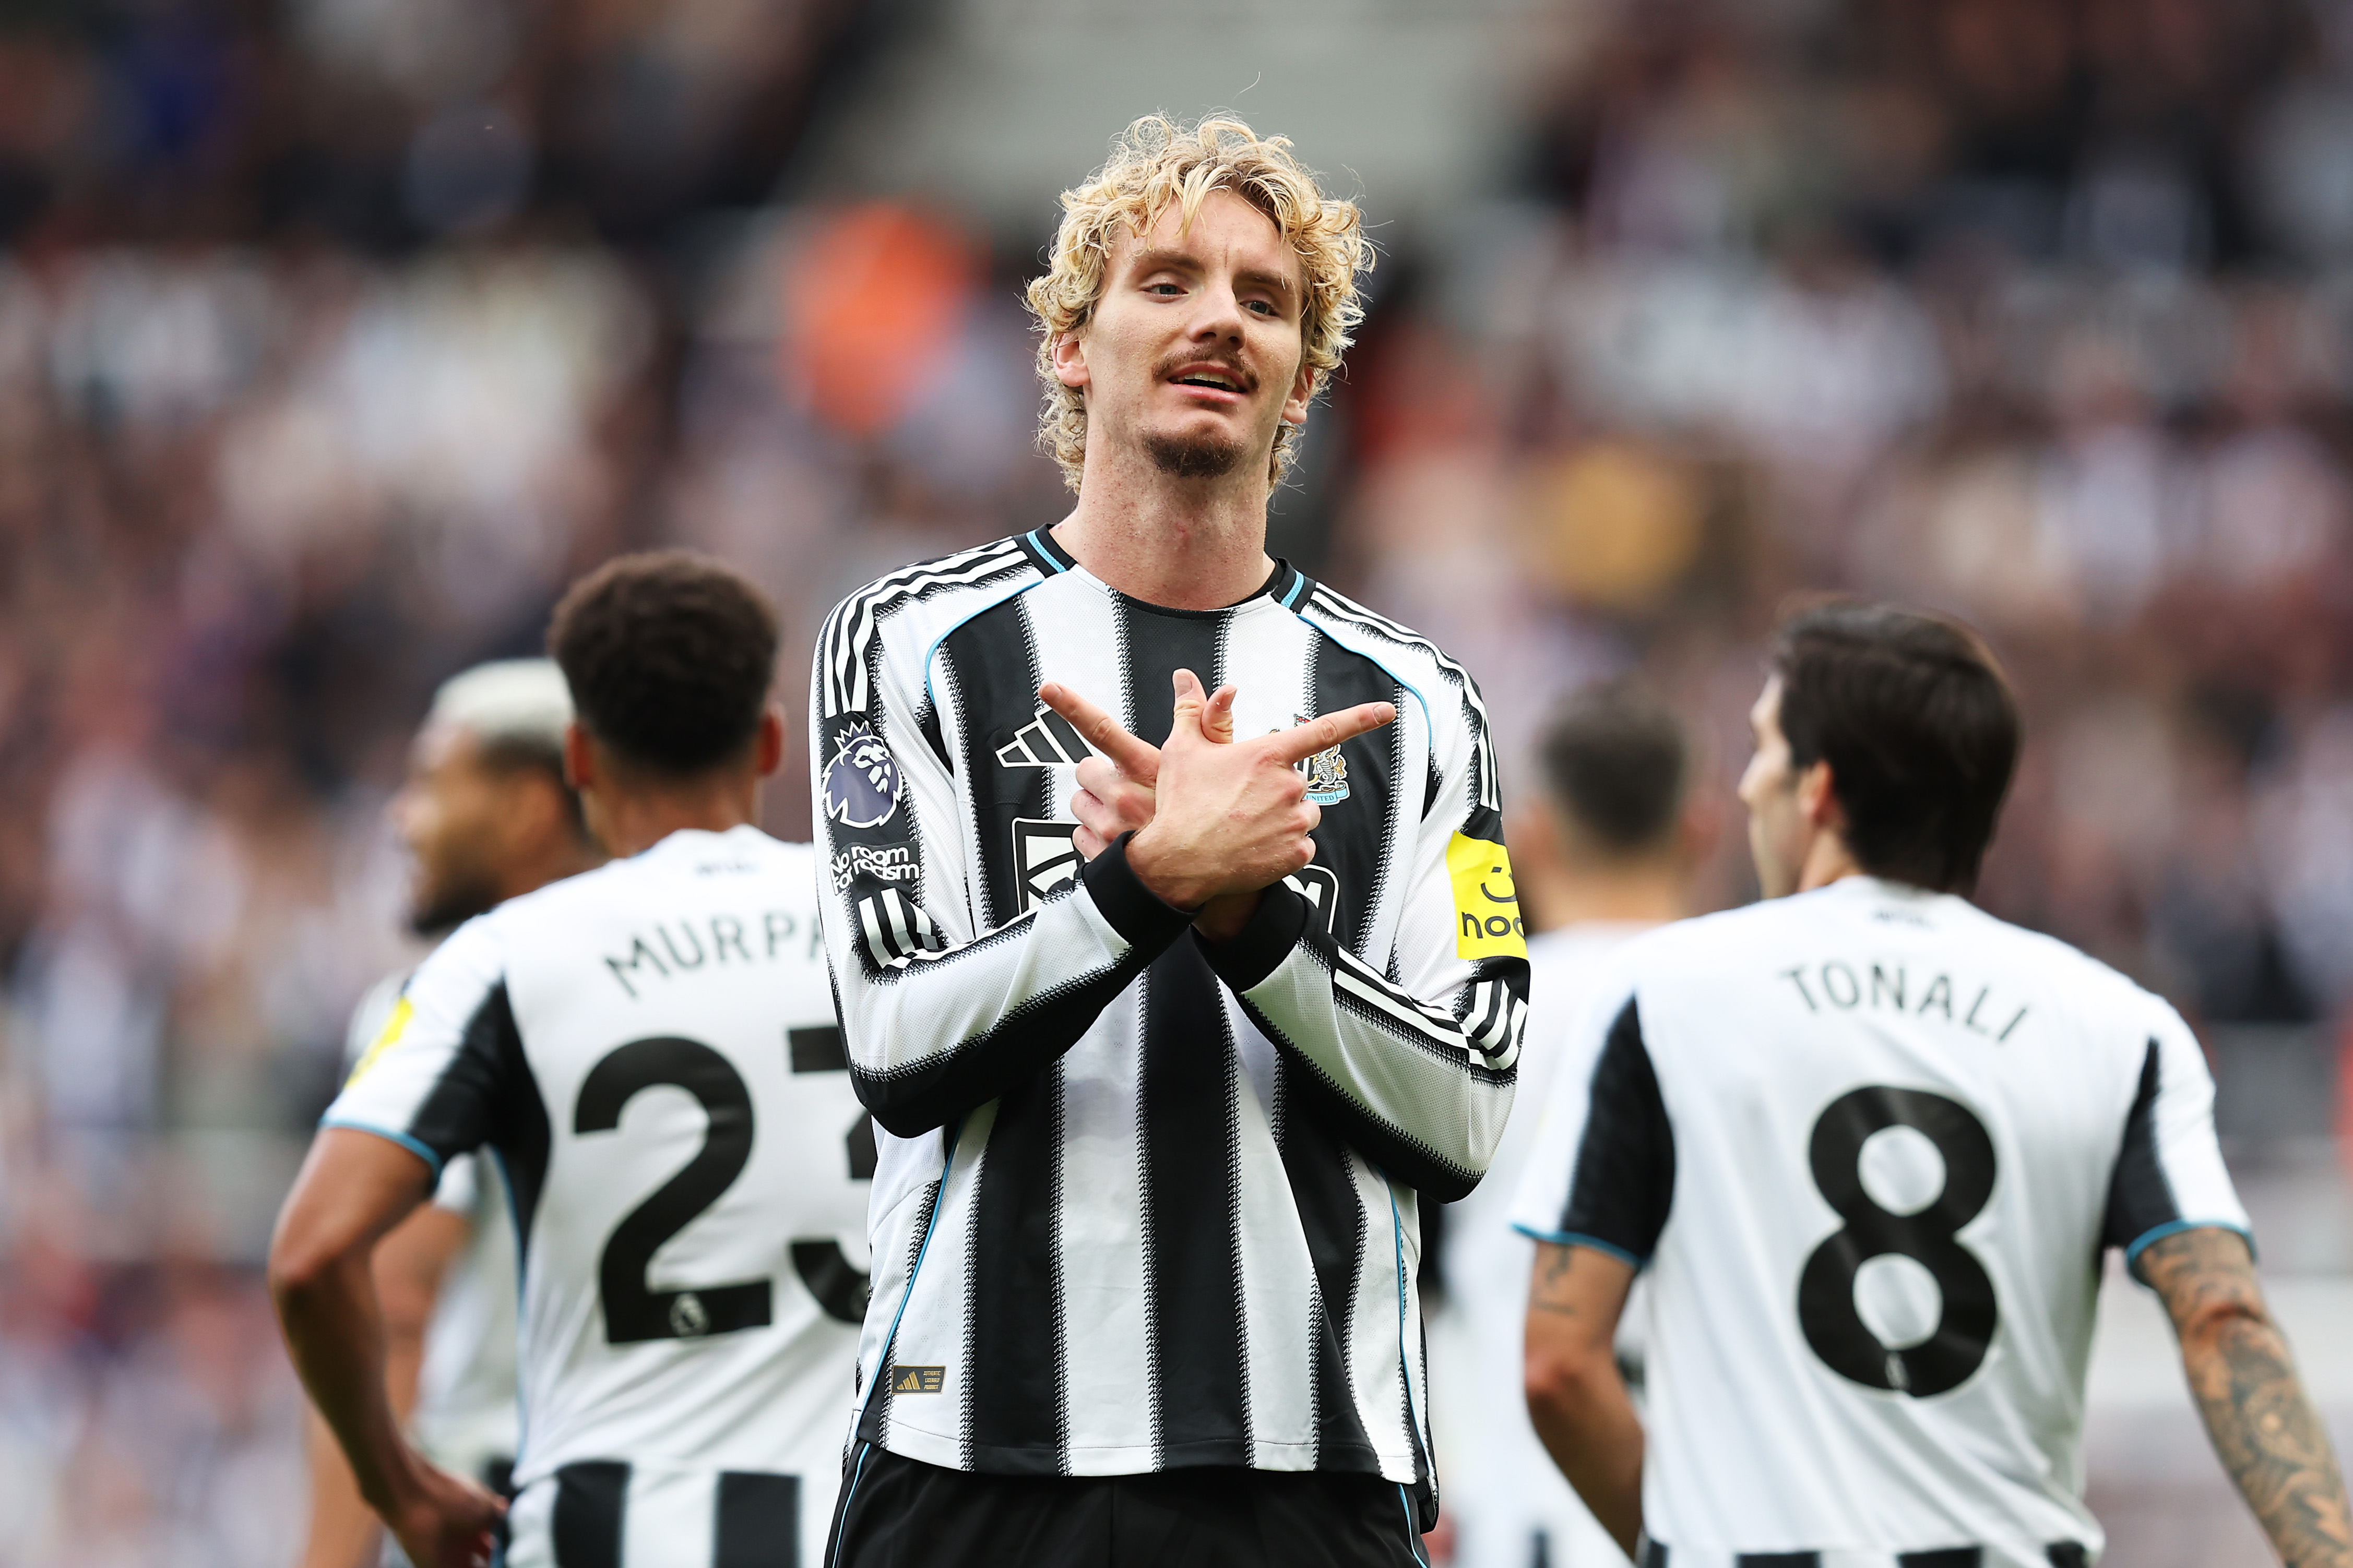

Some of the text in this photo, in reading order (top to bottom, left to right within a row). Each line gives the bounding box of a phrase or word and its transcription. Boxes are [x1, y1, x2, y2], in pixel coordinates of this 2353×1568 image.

[829, 846, 909, 881] No room
[853, 858, 920, 881] racism
[1779, 959, 2028, 1042] TONALI
[1797, 1084, 1998, 1398] 8
